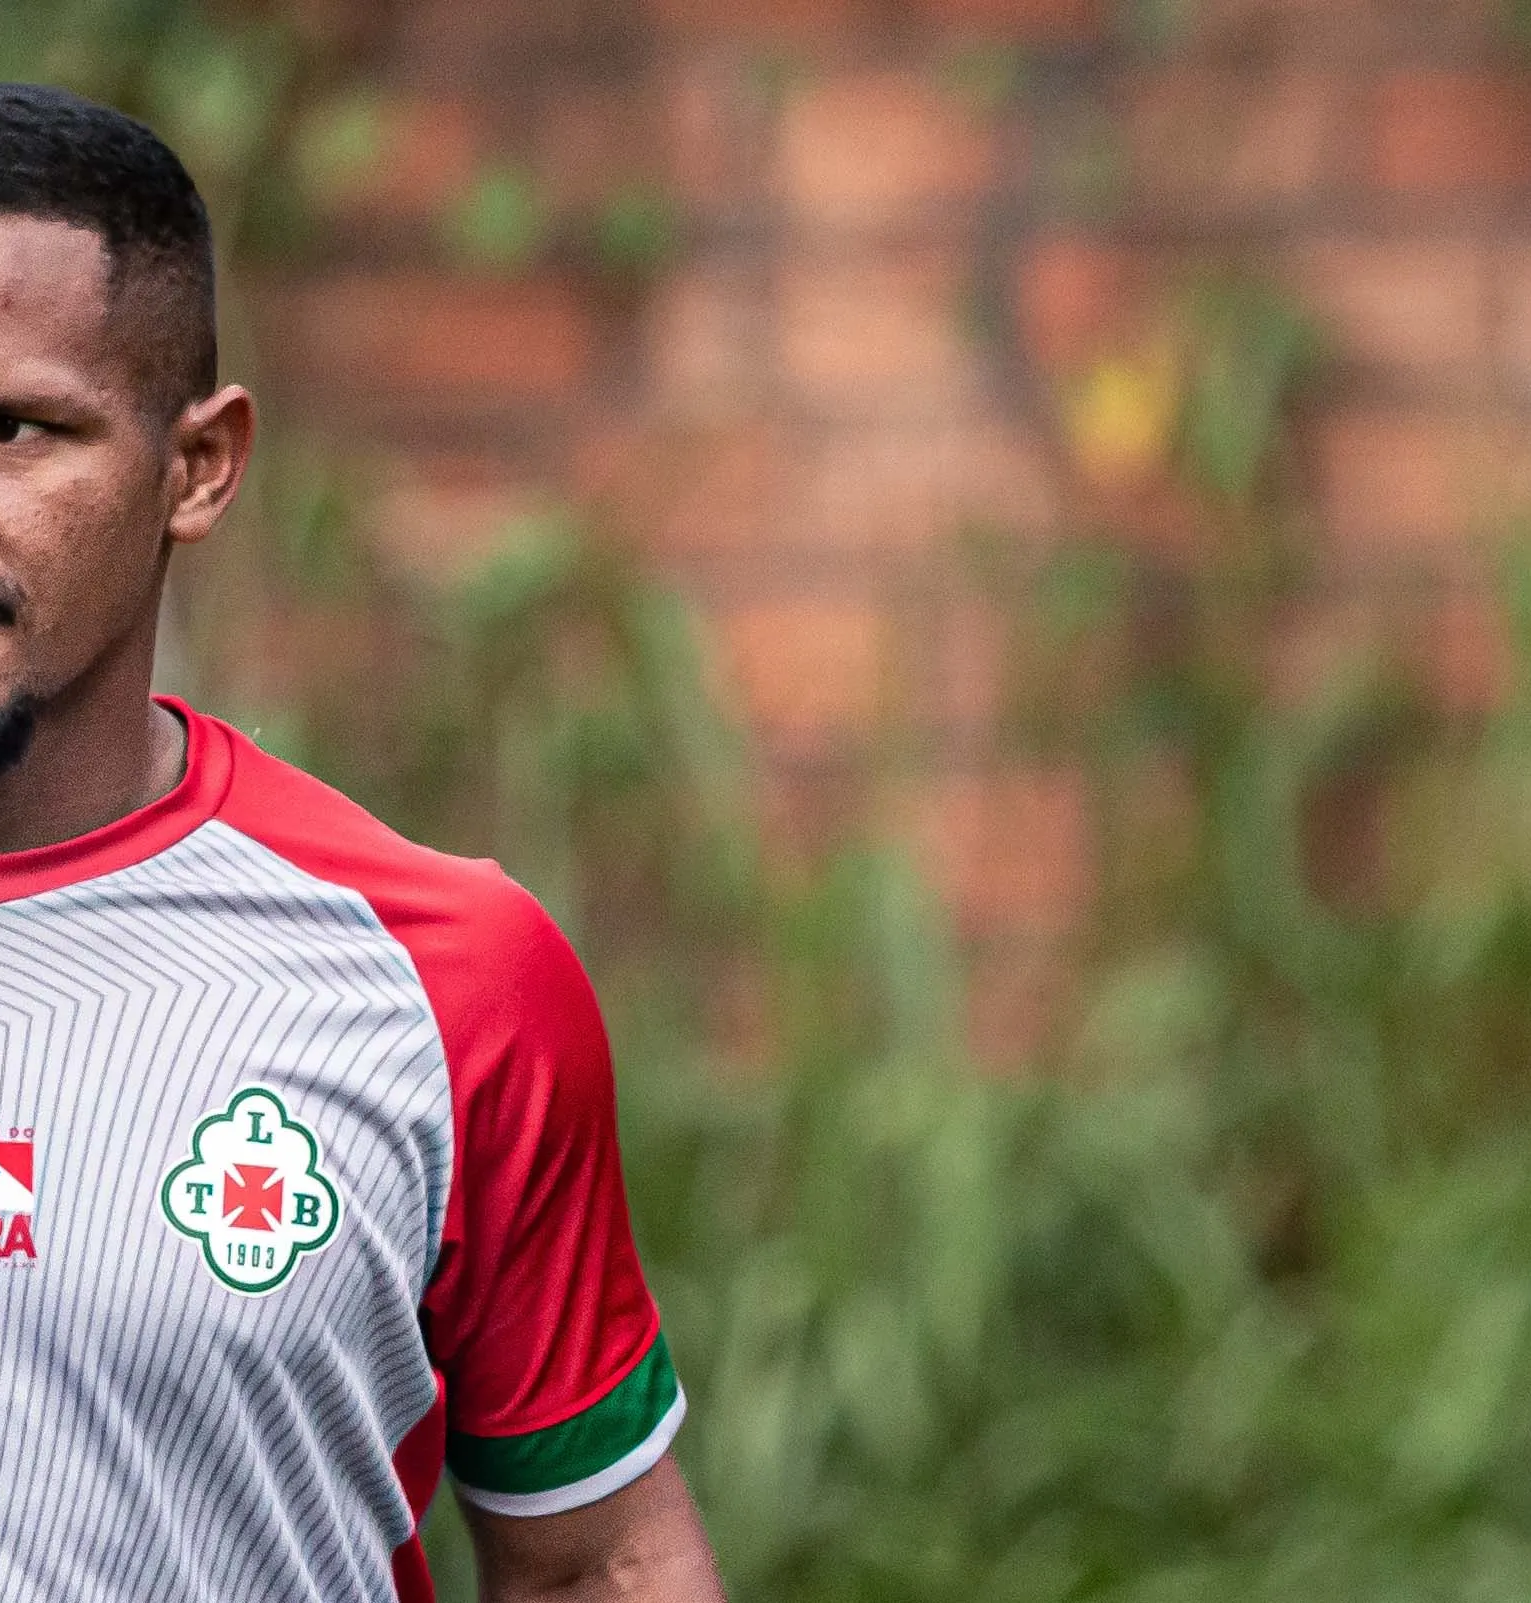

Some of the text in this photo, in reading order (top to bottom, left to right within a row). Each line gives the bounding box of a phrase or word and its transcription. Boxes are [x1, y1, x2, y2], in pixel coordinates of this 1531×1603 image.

[9, 1126, 35, 1138] DO
[245, 1111, 273, 1144] L
[186, 1182, 213, 1215] T
[291, 1193, 321, 1227] B
[226, 1242, 275, 1269] 1903
